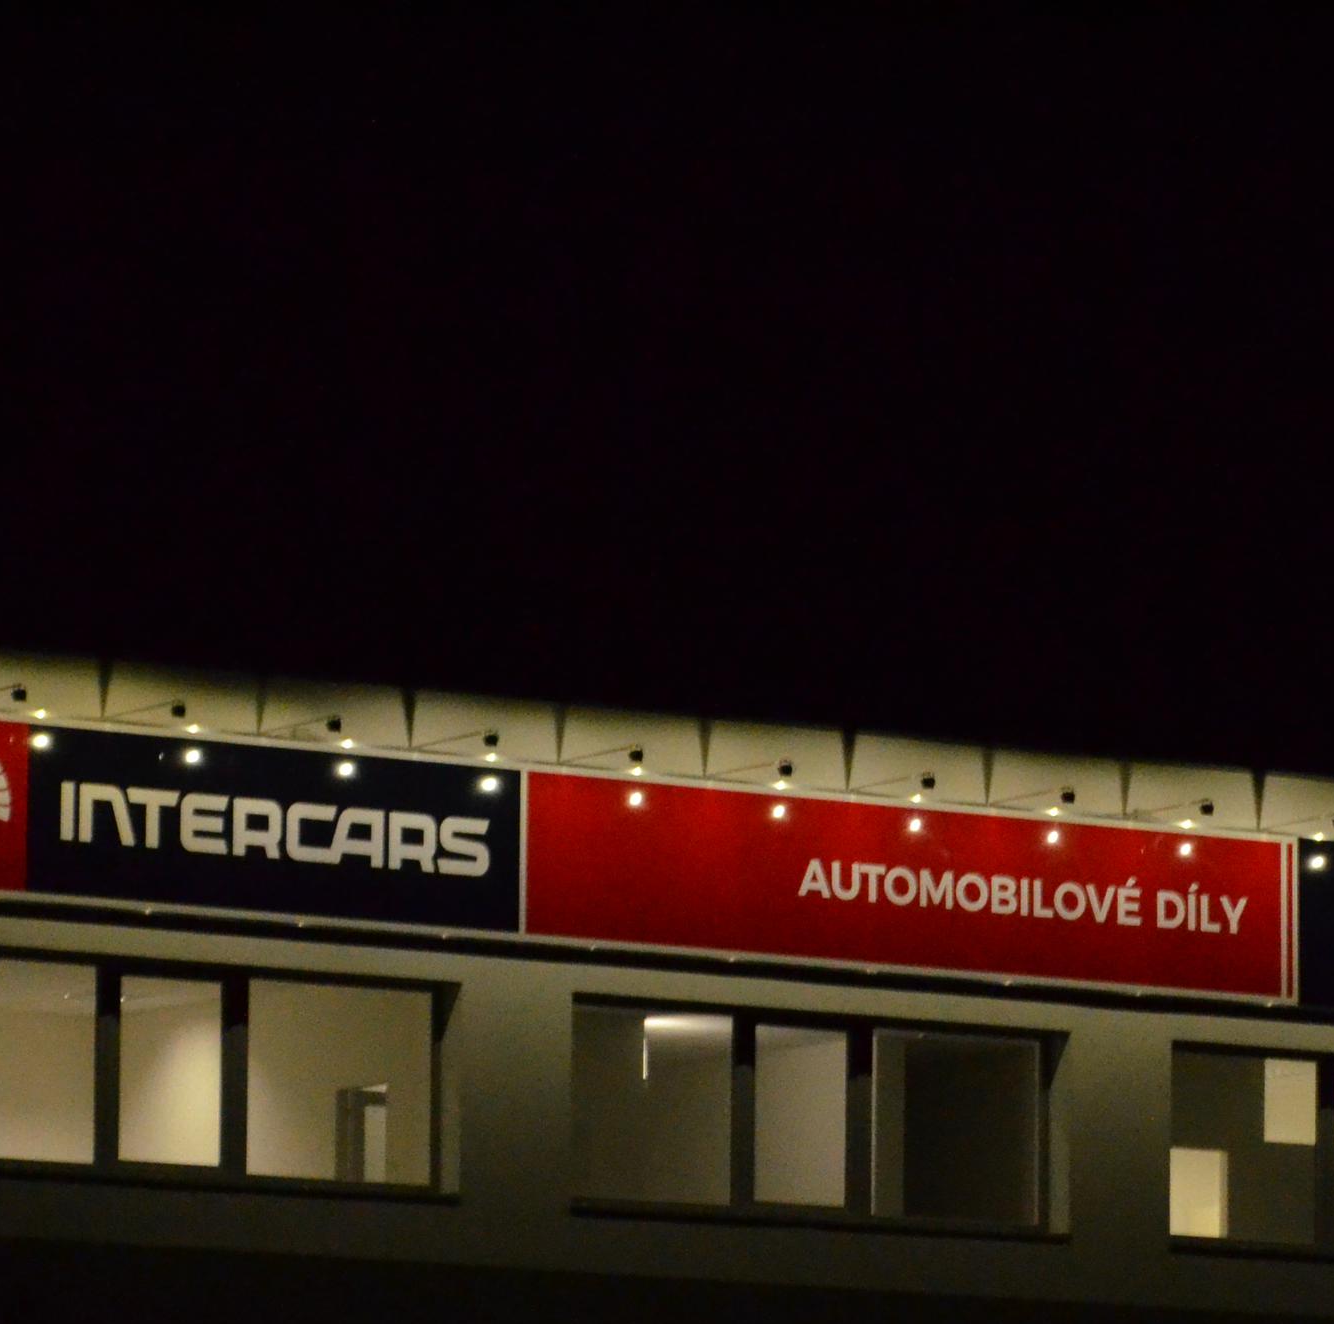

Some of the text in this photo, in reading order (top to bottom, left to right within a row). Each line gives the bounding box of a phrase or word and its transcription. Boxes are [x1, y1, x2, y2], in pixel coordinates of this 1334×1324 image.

[60, 780, 490, 877] INTERCARS
[798, 858, 1248, 935] AUTOMOBILOVÉ DÍLY
